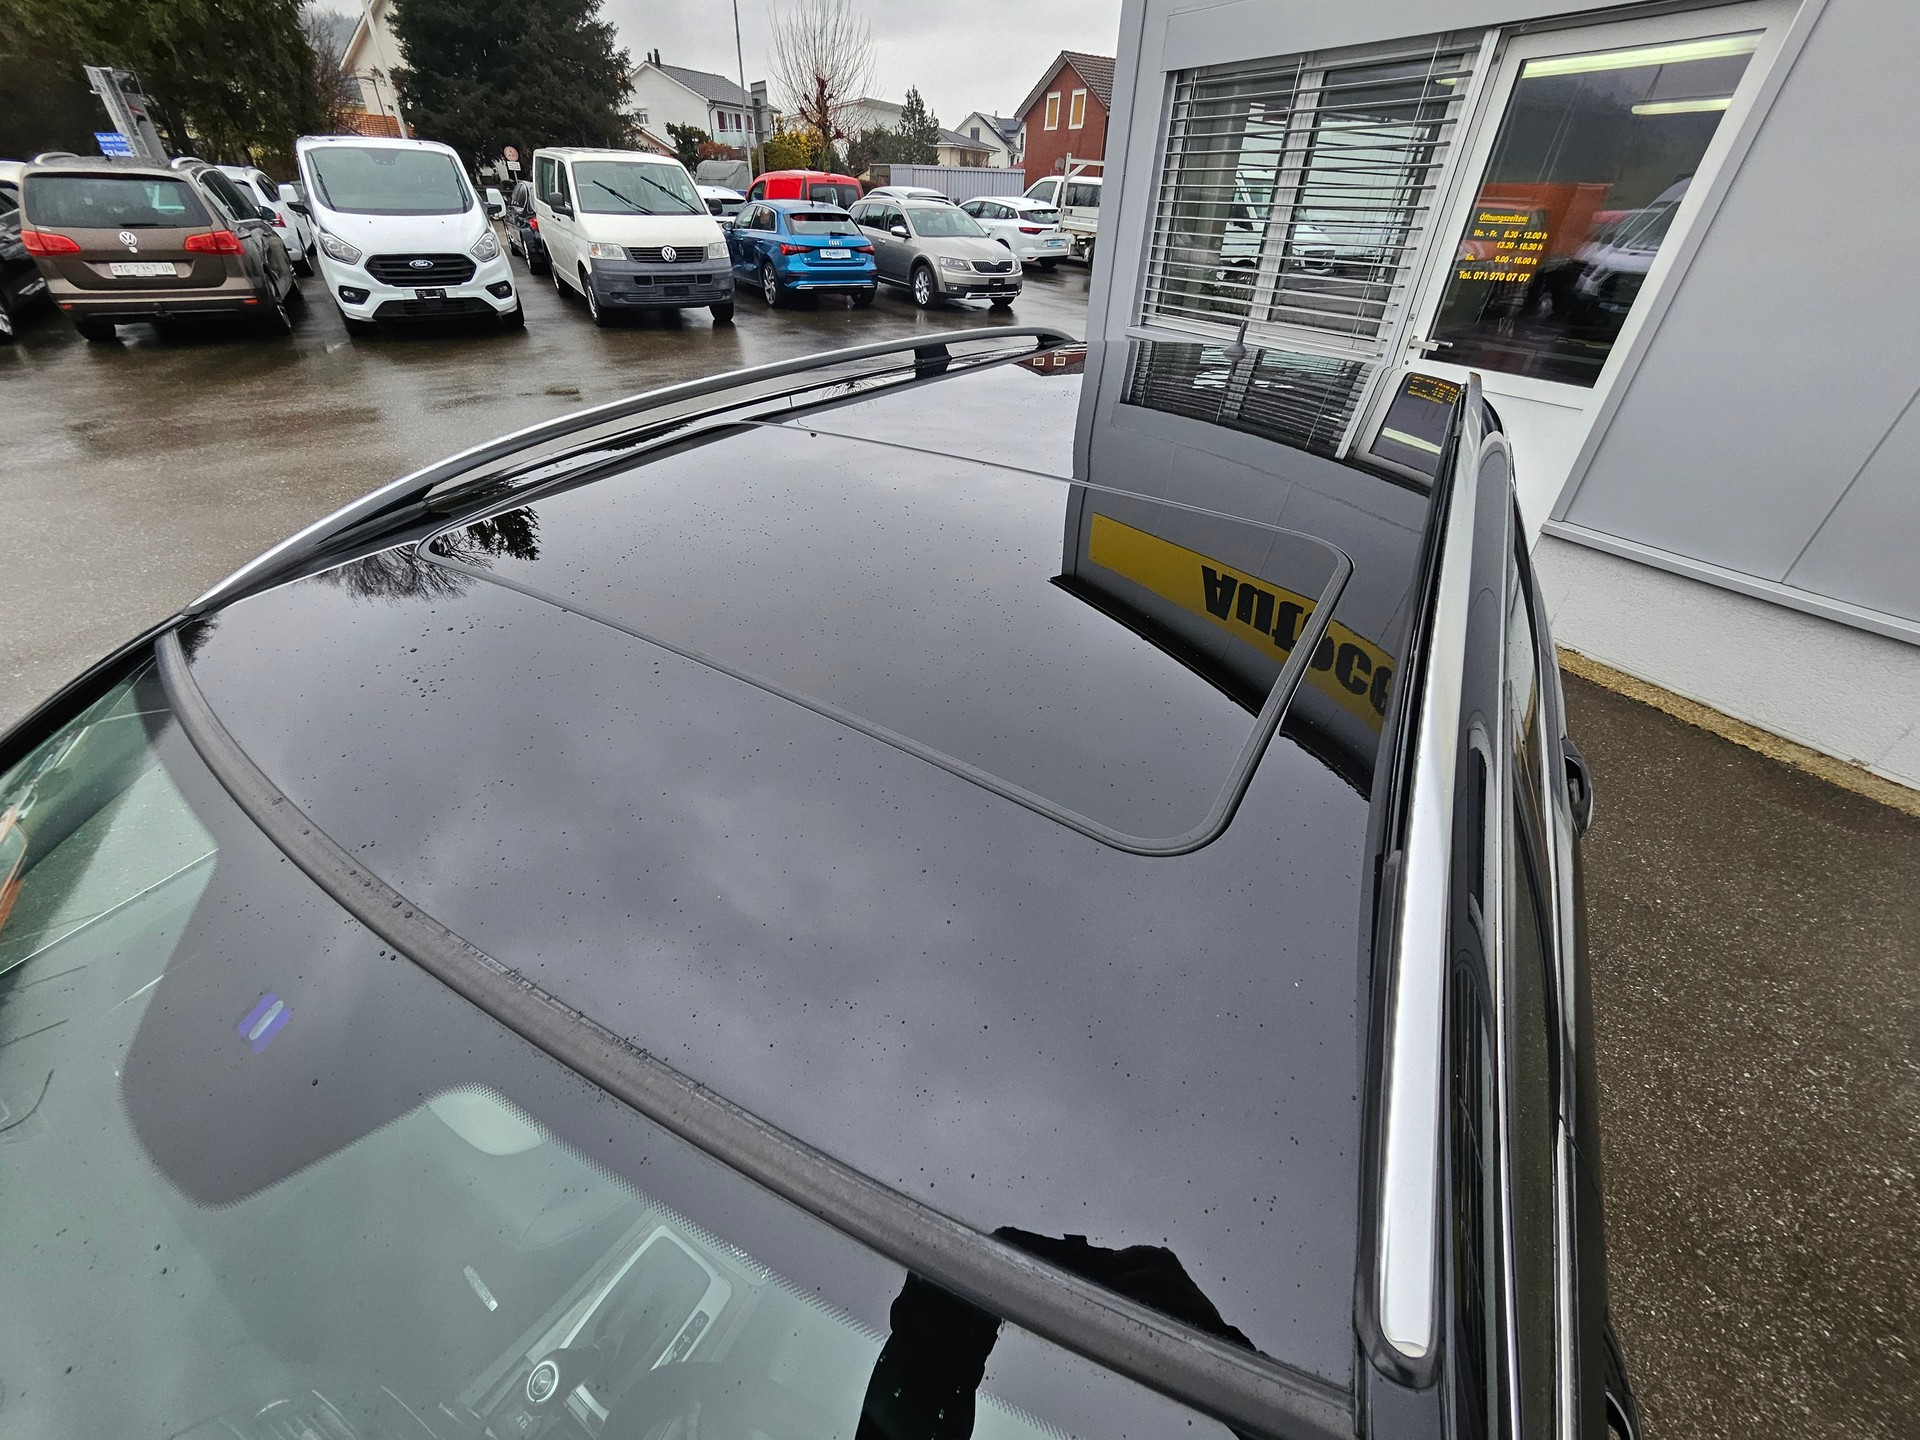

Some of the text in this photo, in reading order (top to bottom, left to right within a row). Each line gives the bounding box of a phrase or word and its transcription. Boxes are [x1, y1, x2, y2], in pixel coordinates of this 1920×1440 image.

[1479, 212, 1529, 223] Öffnungszeiten:
[1474, 229, 1485, 237] Mo.
[1504, 231, 1518, 239] 8.30
[1523, 231, 1541, 240] 12.00
[1542, 232, 1548, 240] h
[1496, 241, 1514, 250] 13.30
[1537, 243, 1543, 251] h
[1465, 253, 1475, 261] Sa.
[119, 264, 131, 273] TG
[1459, 270, 1530, 283] Tel. 071 970 07 07
